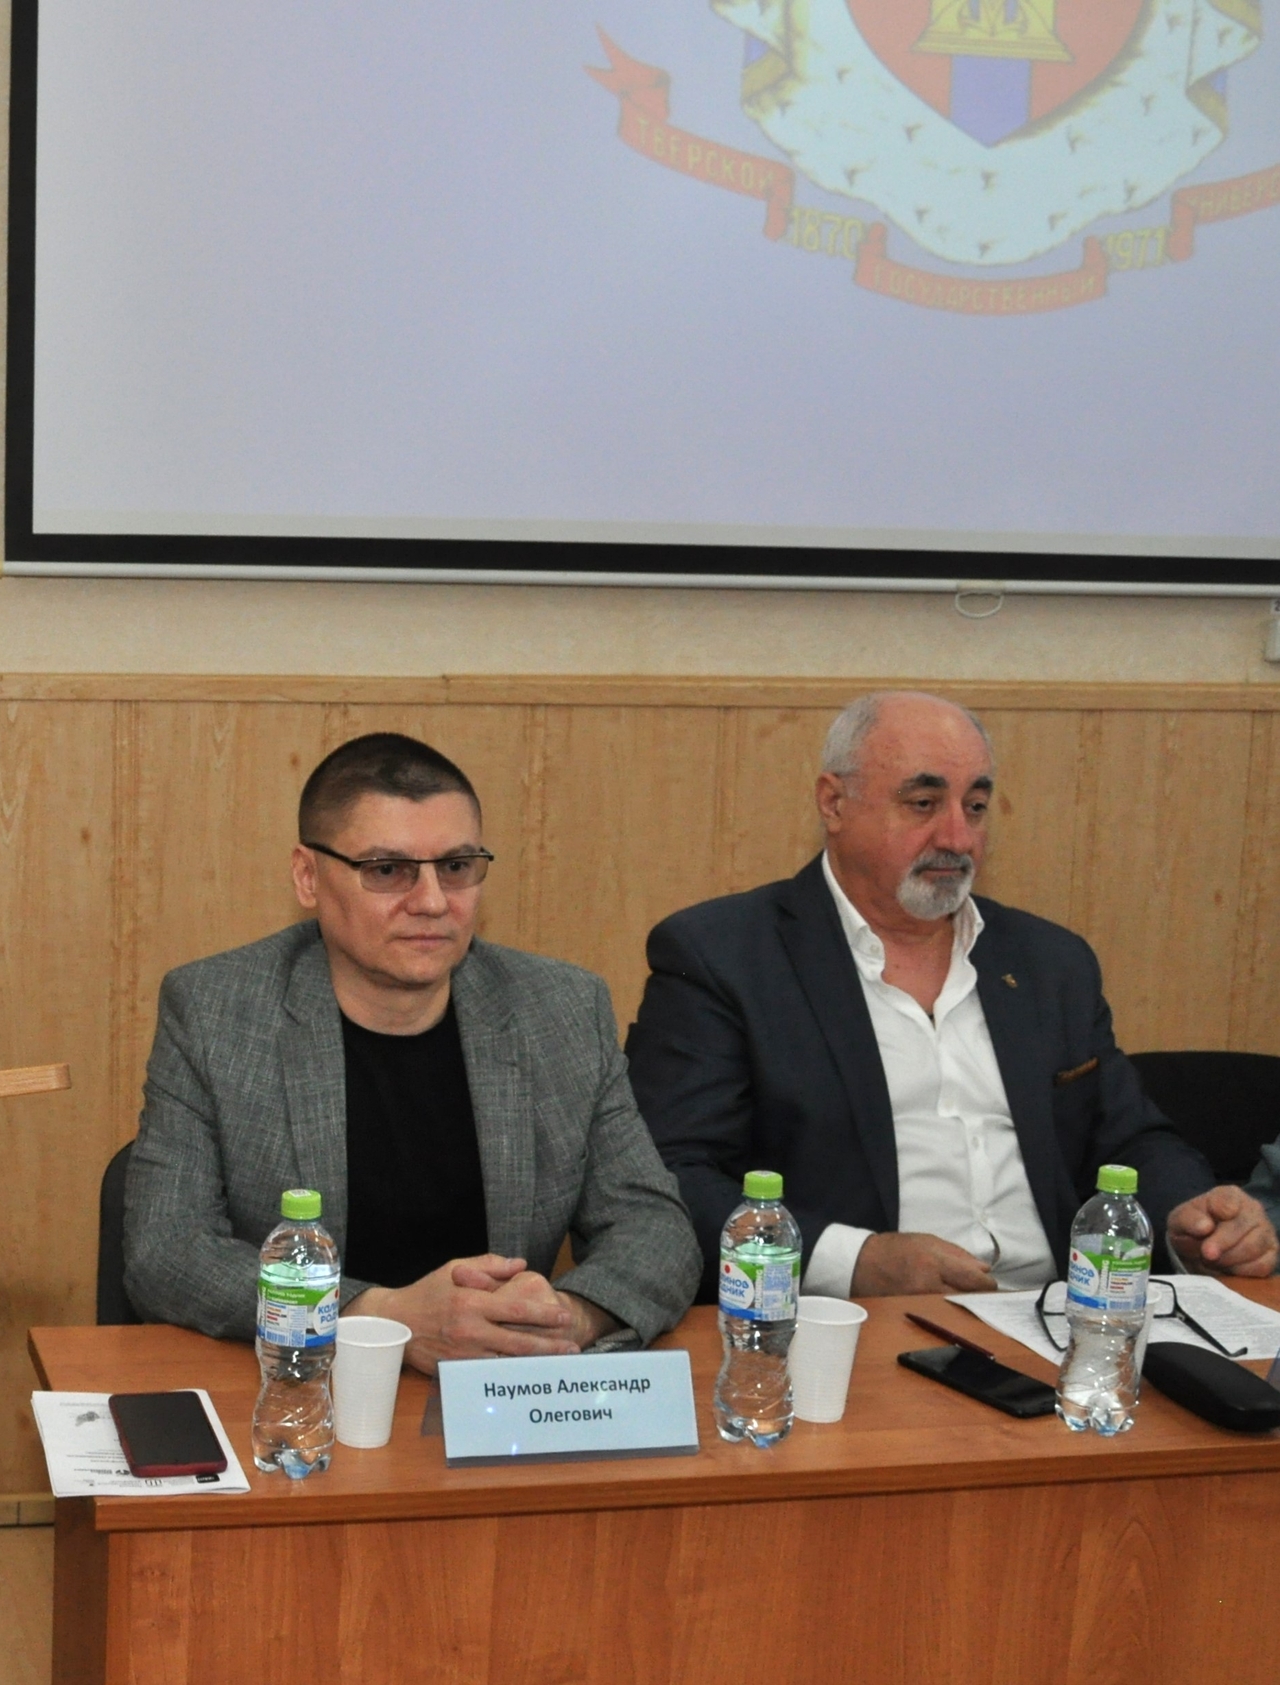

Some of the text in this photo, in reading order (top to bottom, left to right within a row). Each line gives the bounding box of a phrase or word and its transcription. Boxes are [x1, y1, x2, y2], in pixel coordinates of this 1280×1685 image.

[790, 206, 864, 260] 1870
[484, 1377, 651, 1399] Наумов Александр
[529, 1406, 613, 1424] Олегович
